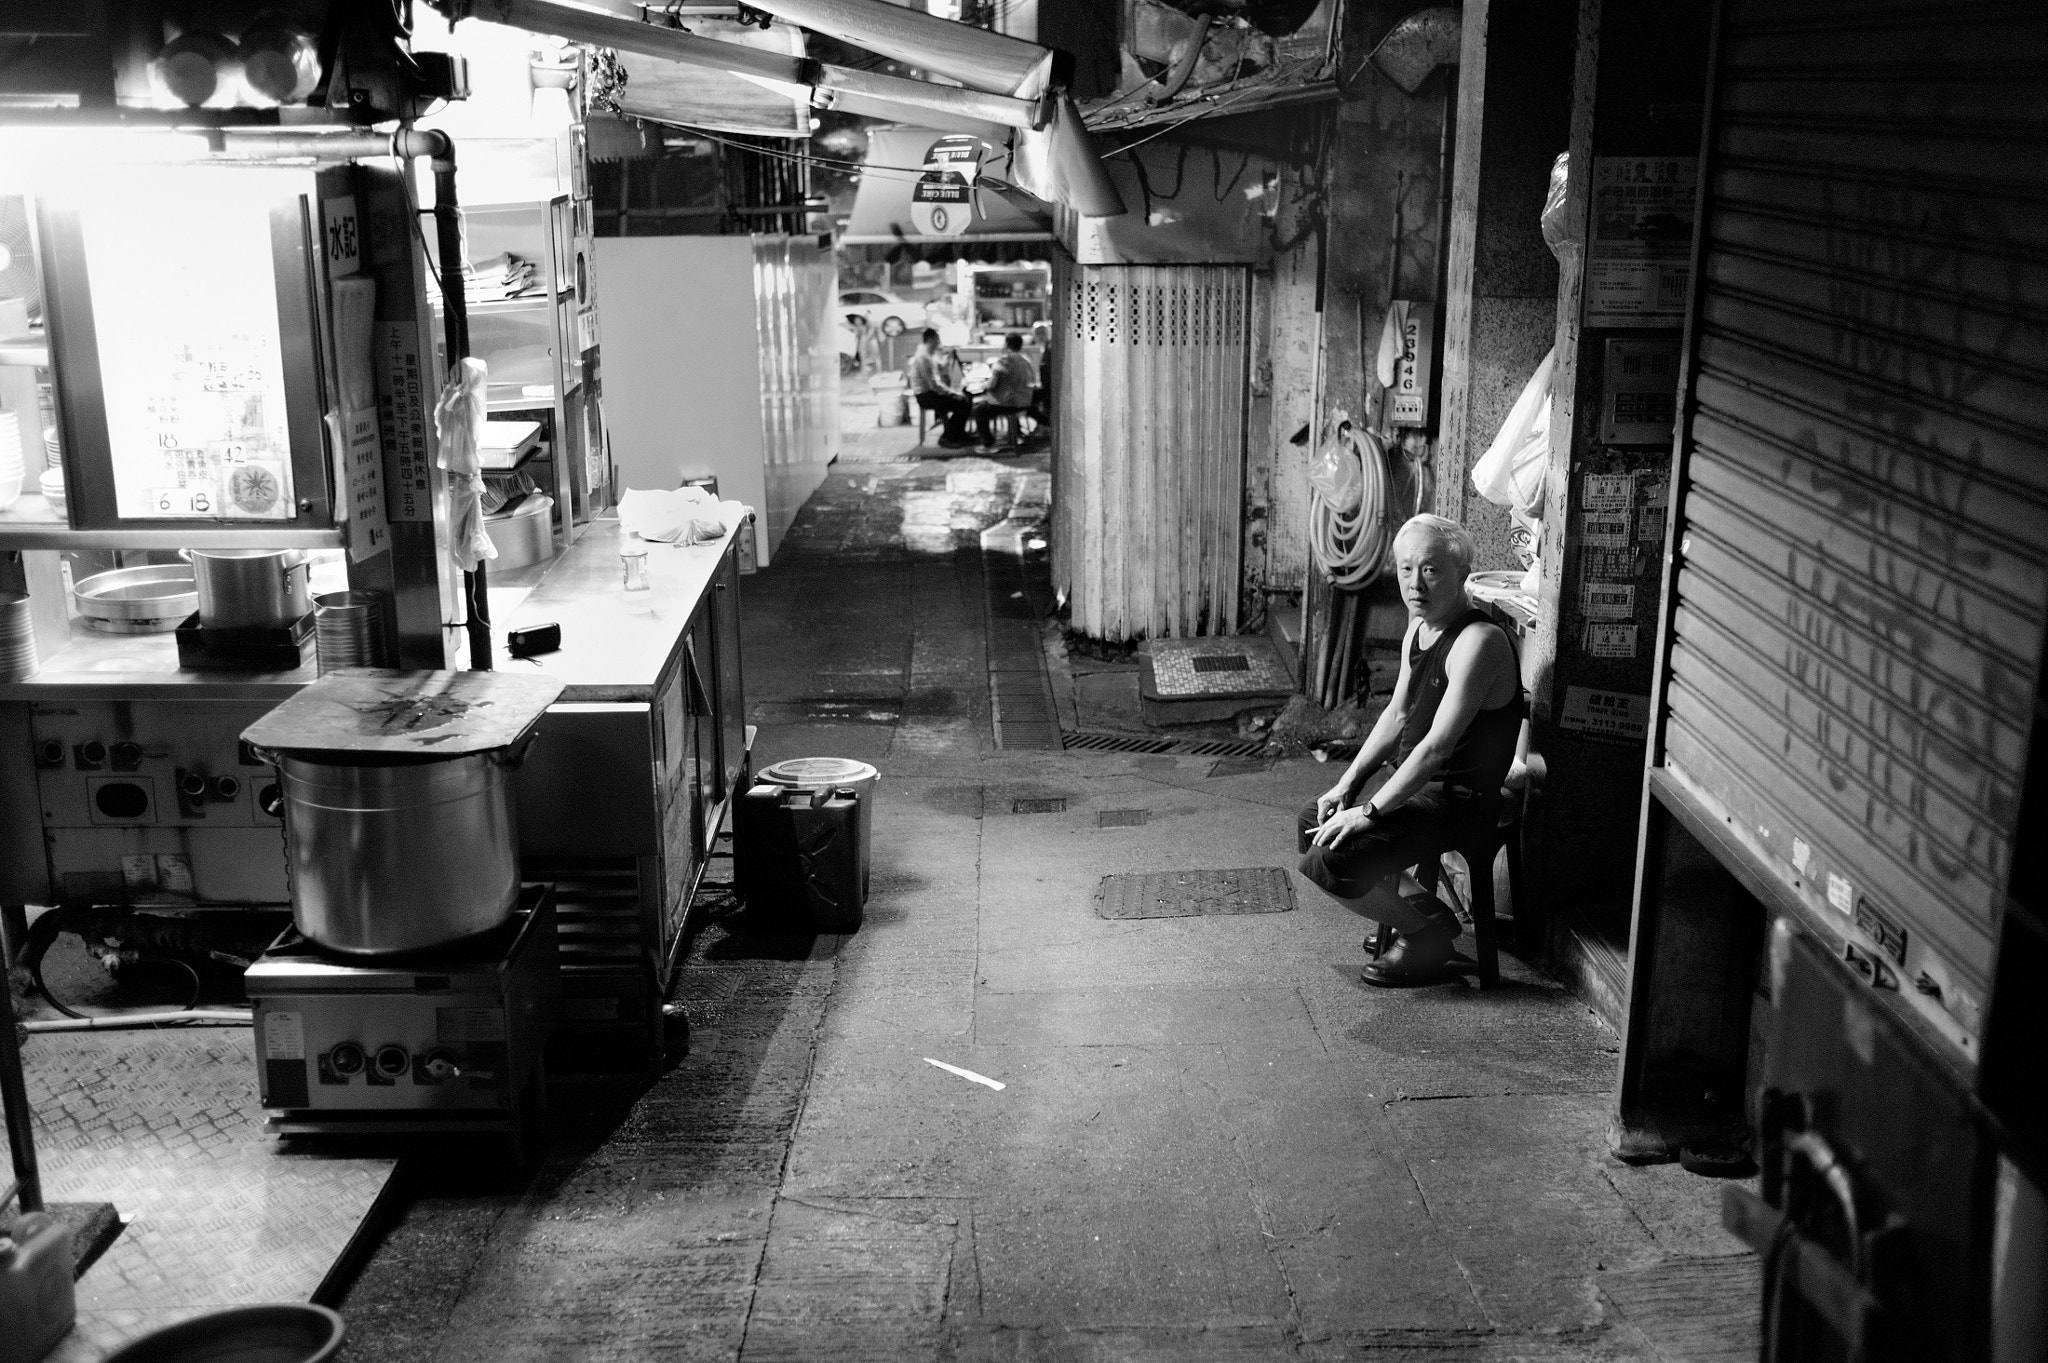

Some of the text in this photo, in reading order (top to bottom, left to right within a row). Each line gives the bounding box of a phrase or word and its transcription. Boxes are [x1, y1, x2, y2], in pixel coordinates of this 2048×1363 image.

[921, 190, 960, 199] BLUE GIRL
[1403, 324, 1417, 390] 23946
[224, 446, 245, 463] 42
[160, 492, 170, 510] 6
[190, 492, 210, 512] 18
[1591, 717, 1616, 728] 3113
